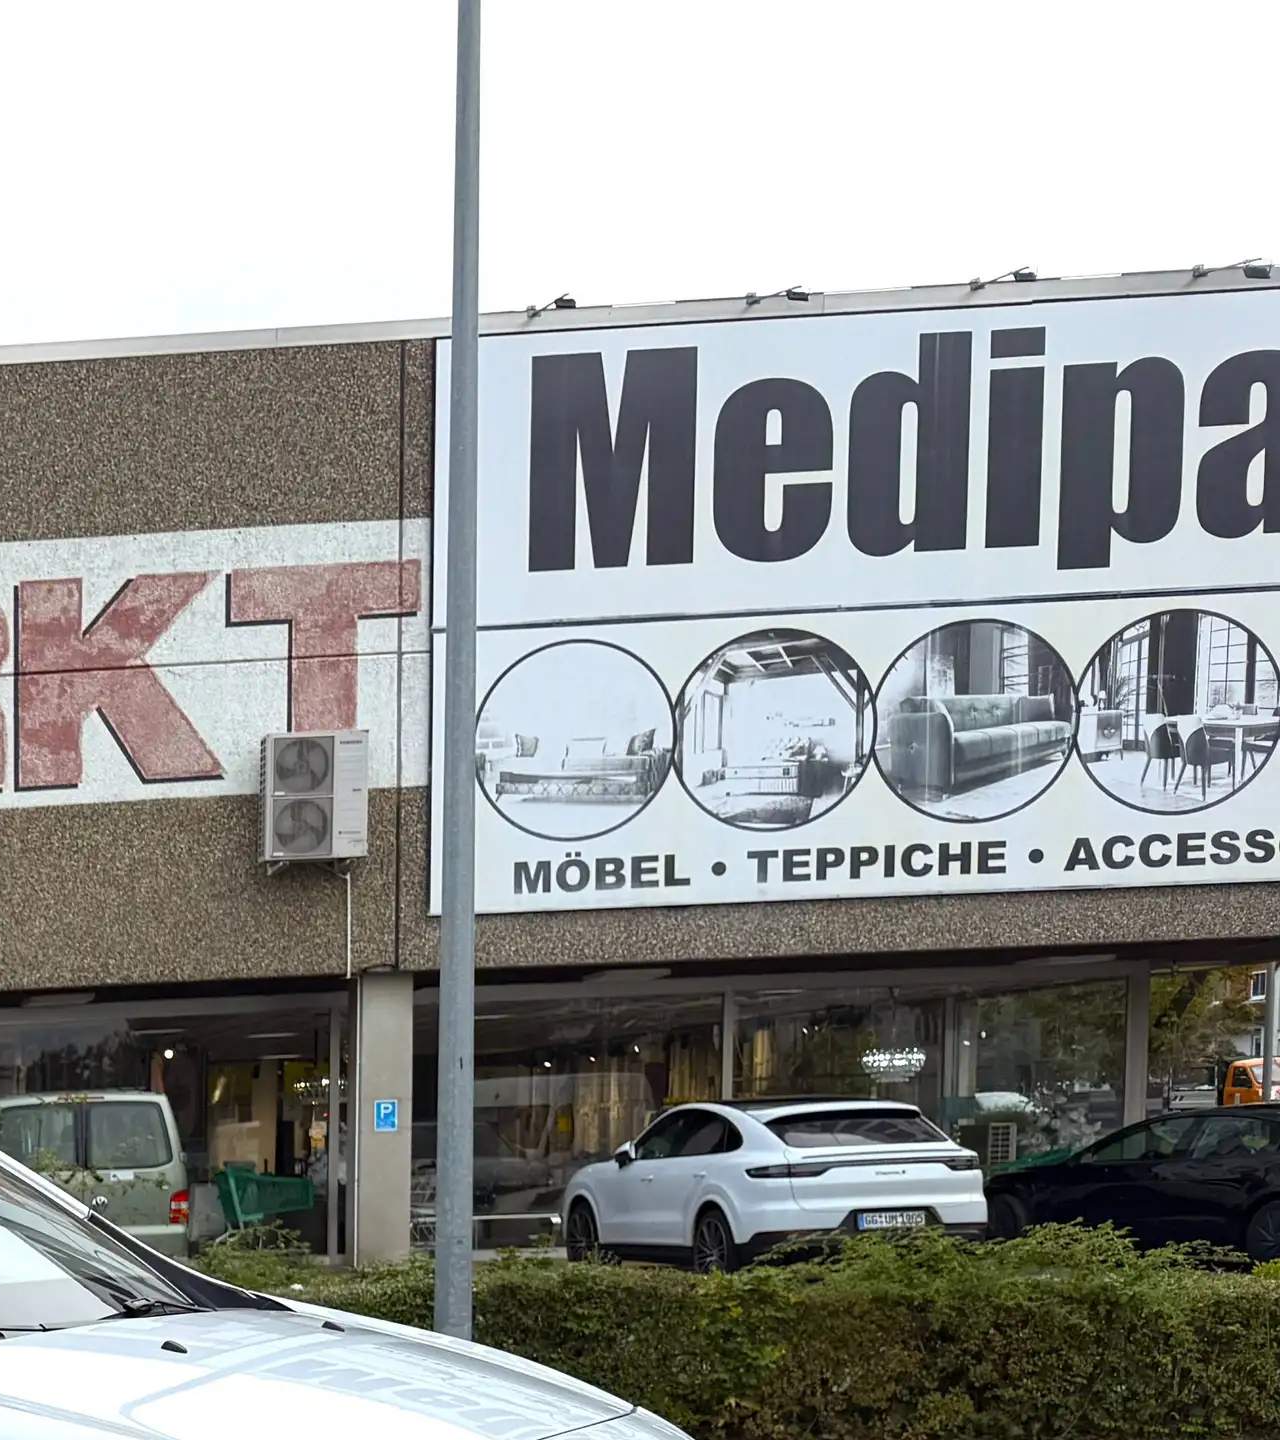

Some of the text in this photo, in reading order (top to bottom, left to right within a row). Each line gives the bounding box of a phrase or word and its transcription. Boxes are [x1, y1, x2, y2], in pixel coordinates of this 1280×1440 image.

[514, 828, 1280, 895] MÖBEL TEPPICHE ACCESS
[380, 1103, 393, 1120] P
